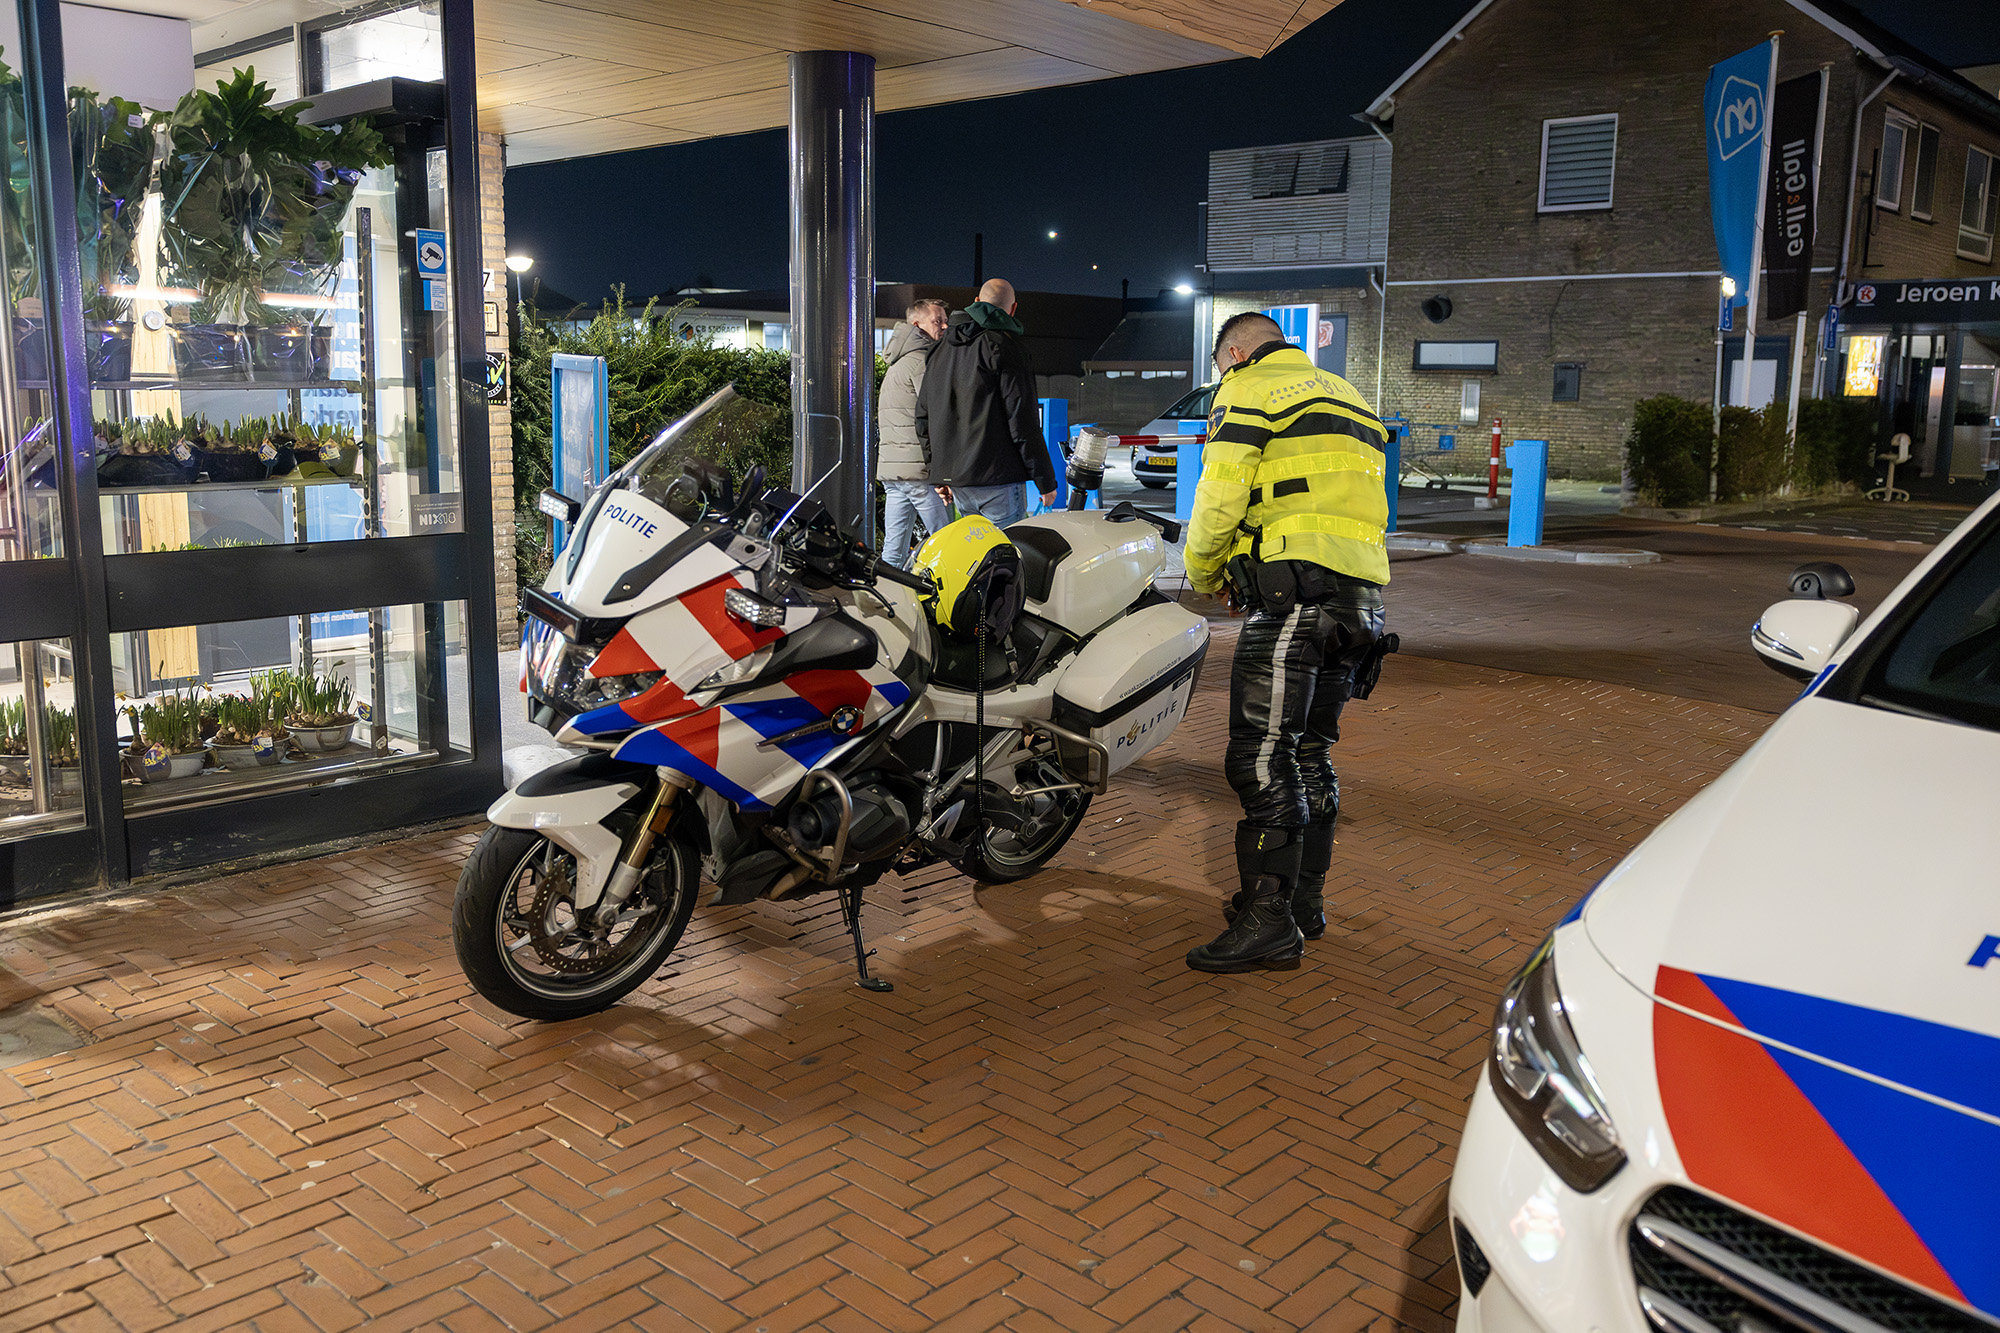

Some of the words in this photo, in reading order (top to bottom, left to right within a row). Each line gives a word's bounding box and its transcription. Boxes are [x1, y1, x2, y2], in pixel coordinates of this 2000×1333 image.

[1896, 283, 1980, 303] Jeroen
[708, 325, 741, 333] STORAGE
[1284, 335, 1301, 344] kom
[419, 512, 456, 526] NIX18
[603, 504, 658, 539] POLITIE
[1116, 700, 1178, 749] POLITIE
